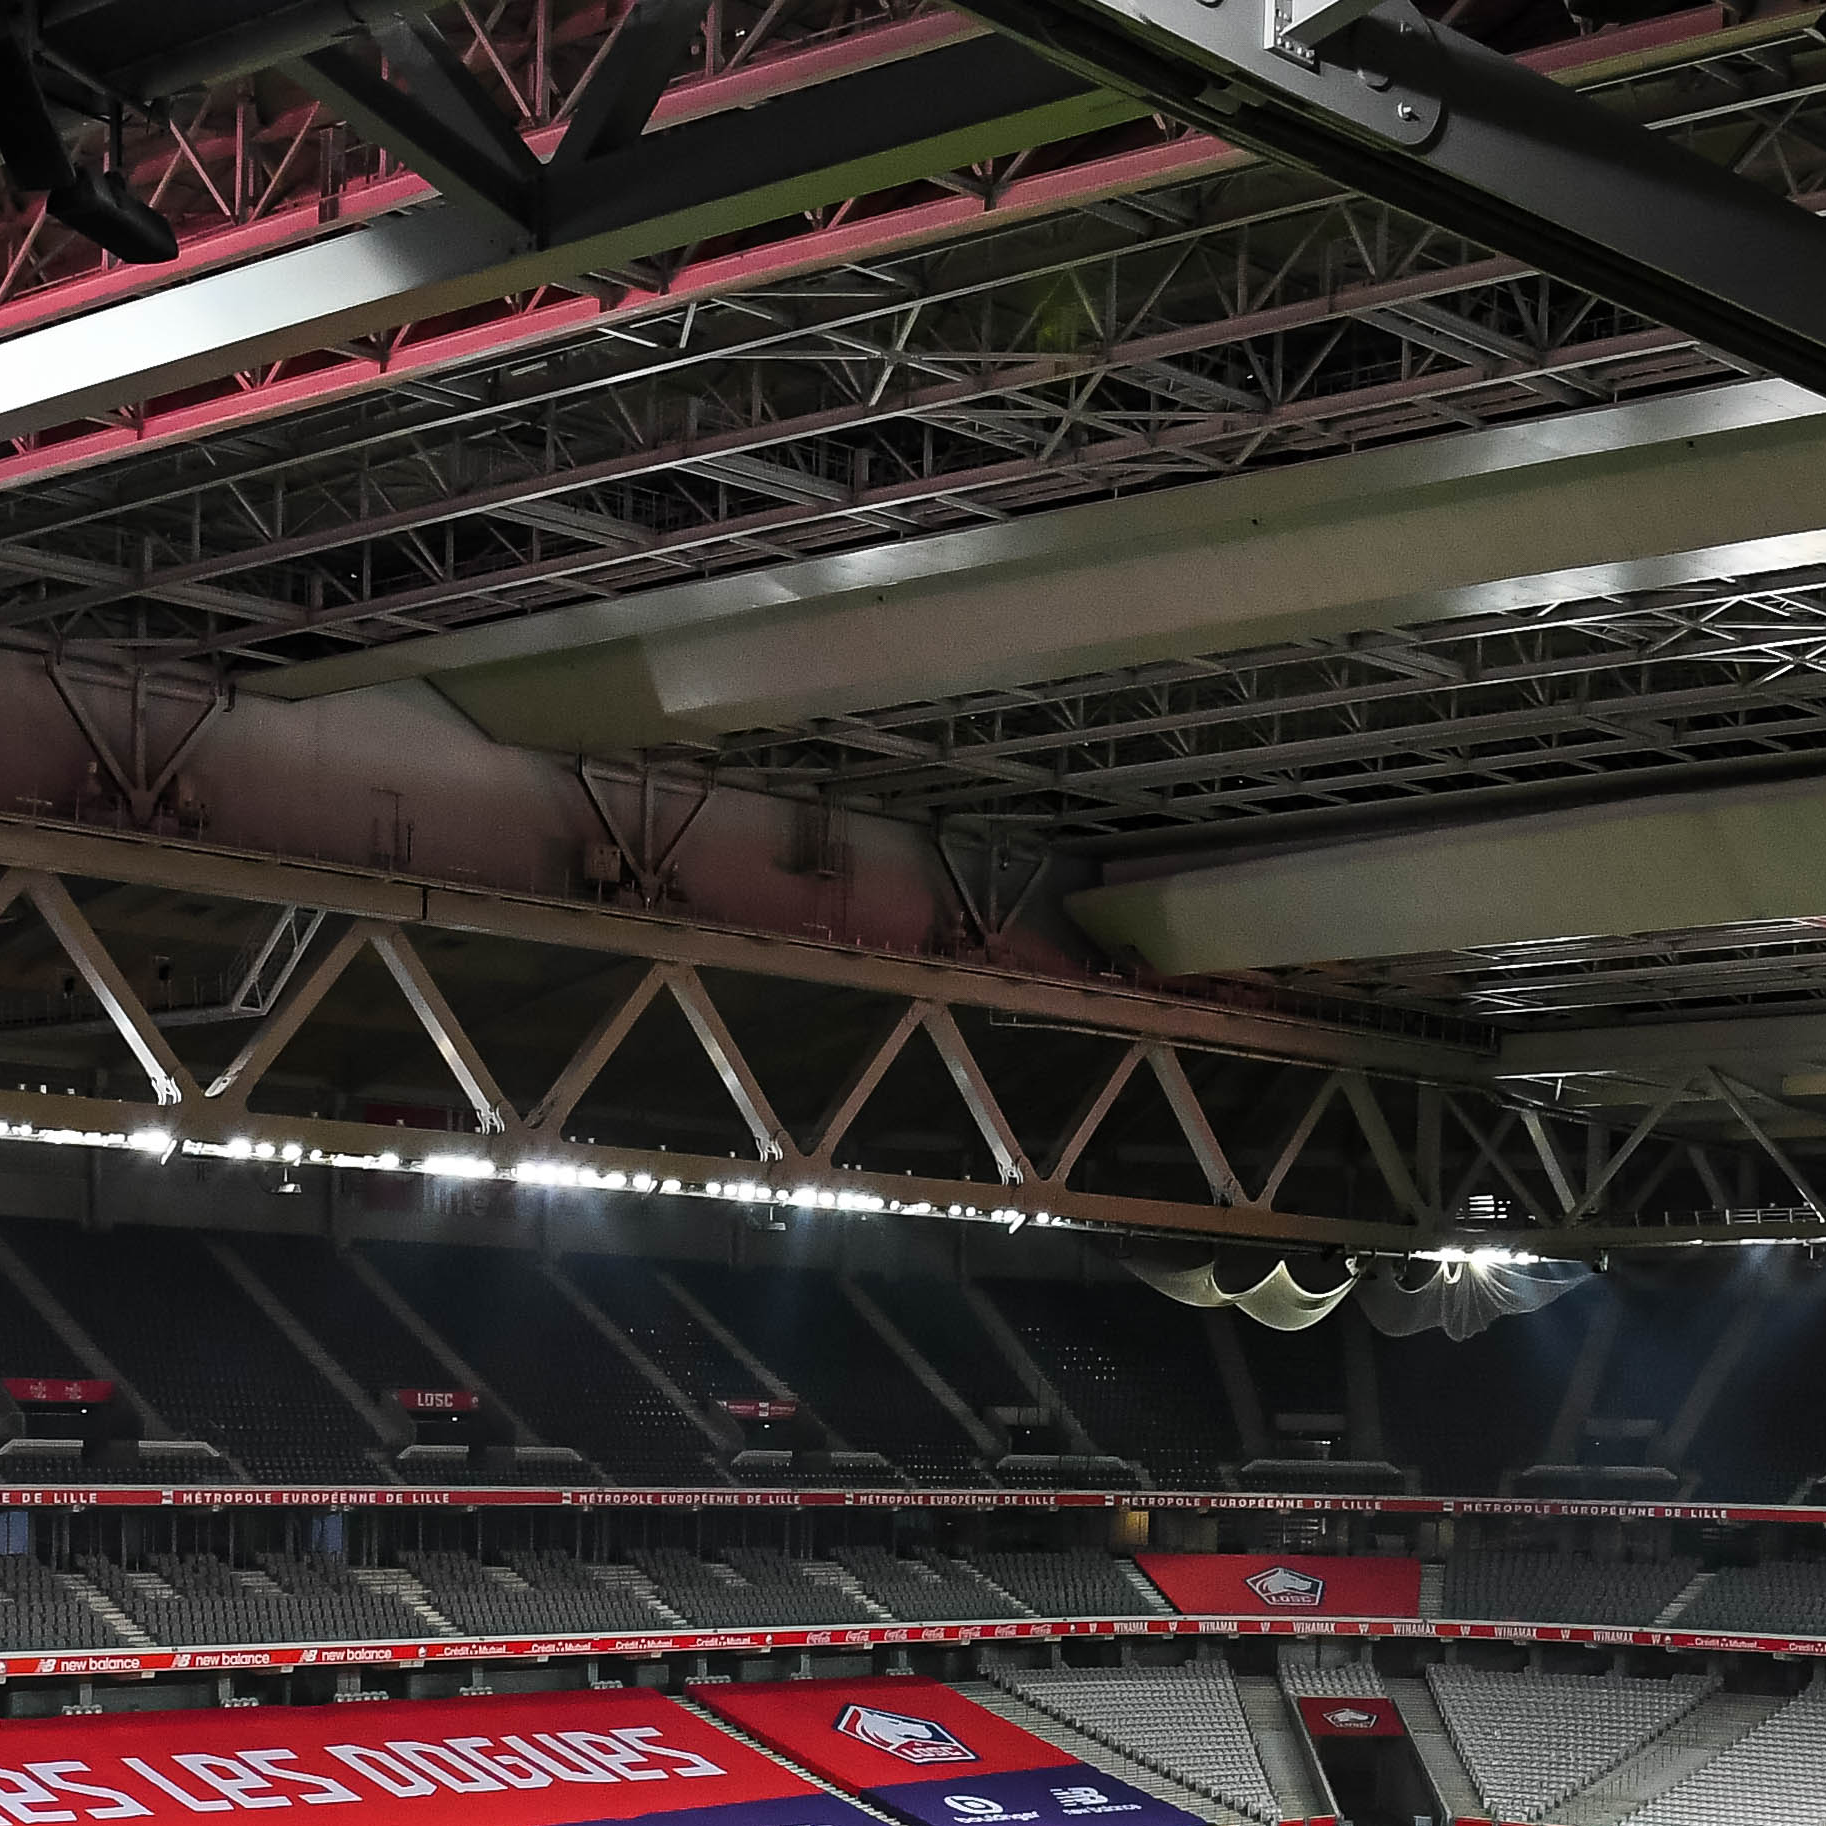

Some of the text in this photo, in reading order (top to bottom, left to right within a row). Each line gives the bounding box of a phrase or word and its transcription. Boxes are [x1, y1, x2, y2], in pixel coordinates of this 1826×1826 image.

[417, 1393, 453, 1407] LOSC
[23, 1493, 41, 1503] DE
[54, 1493, 96, 1503] LILLE
[183, 1490, 448, 1503] MÉTROPOLE EUROPÉENNE DE LILLE
[1665, 1508, 1726, 1518] DE LILLE
[1271, 1595, 1311, 1603] LOSC
[61, 1656, 140, 1671] new balance
[902, 1746, 962, 1759] LOSC
